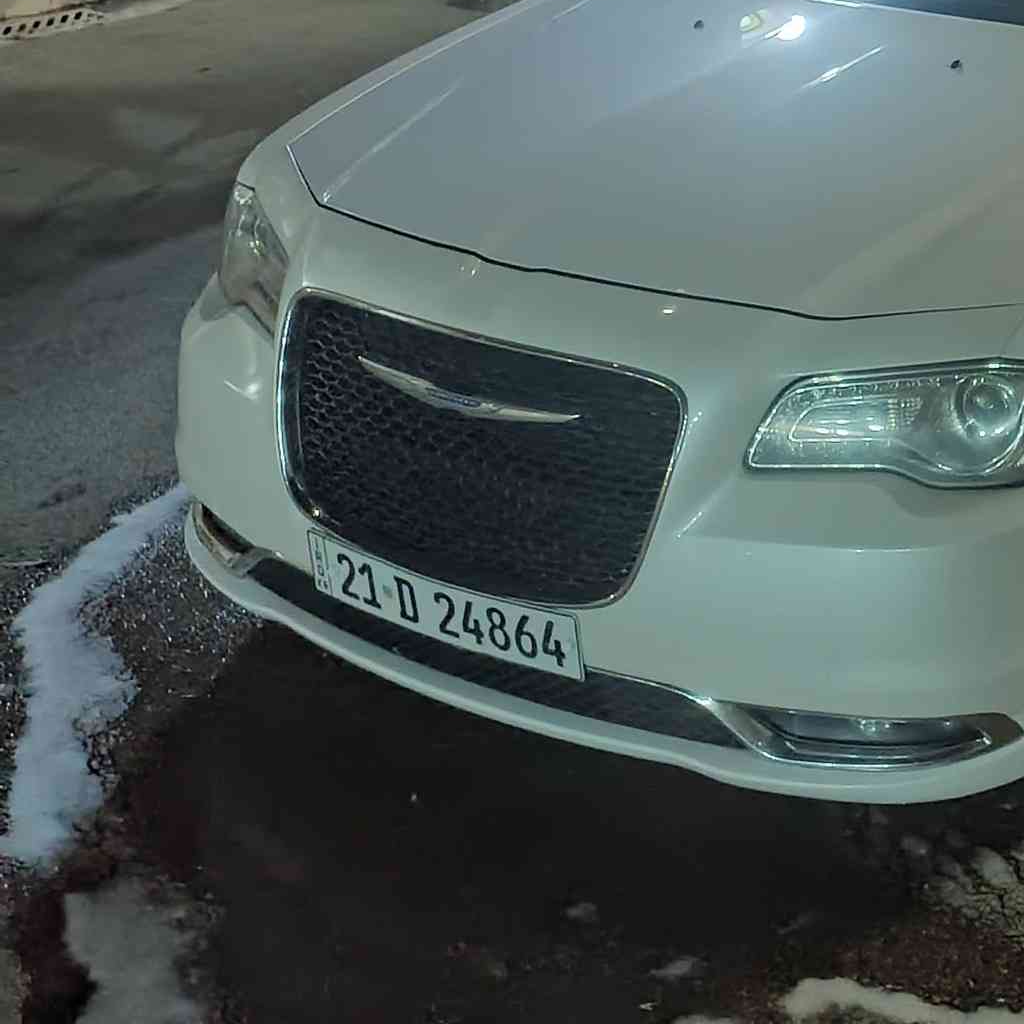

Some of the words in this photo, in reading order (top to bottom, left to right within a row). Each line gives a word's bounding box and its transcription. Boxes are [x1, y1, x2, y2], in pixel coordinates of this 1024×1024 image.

[336, 553, 383, 610] 21
[393, 575, 419, 624] D
[433, 591, 567, 668] 24864
